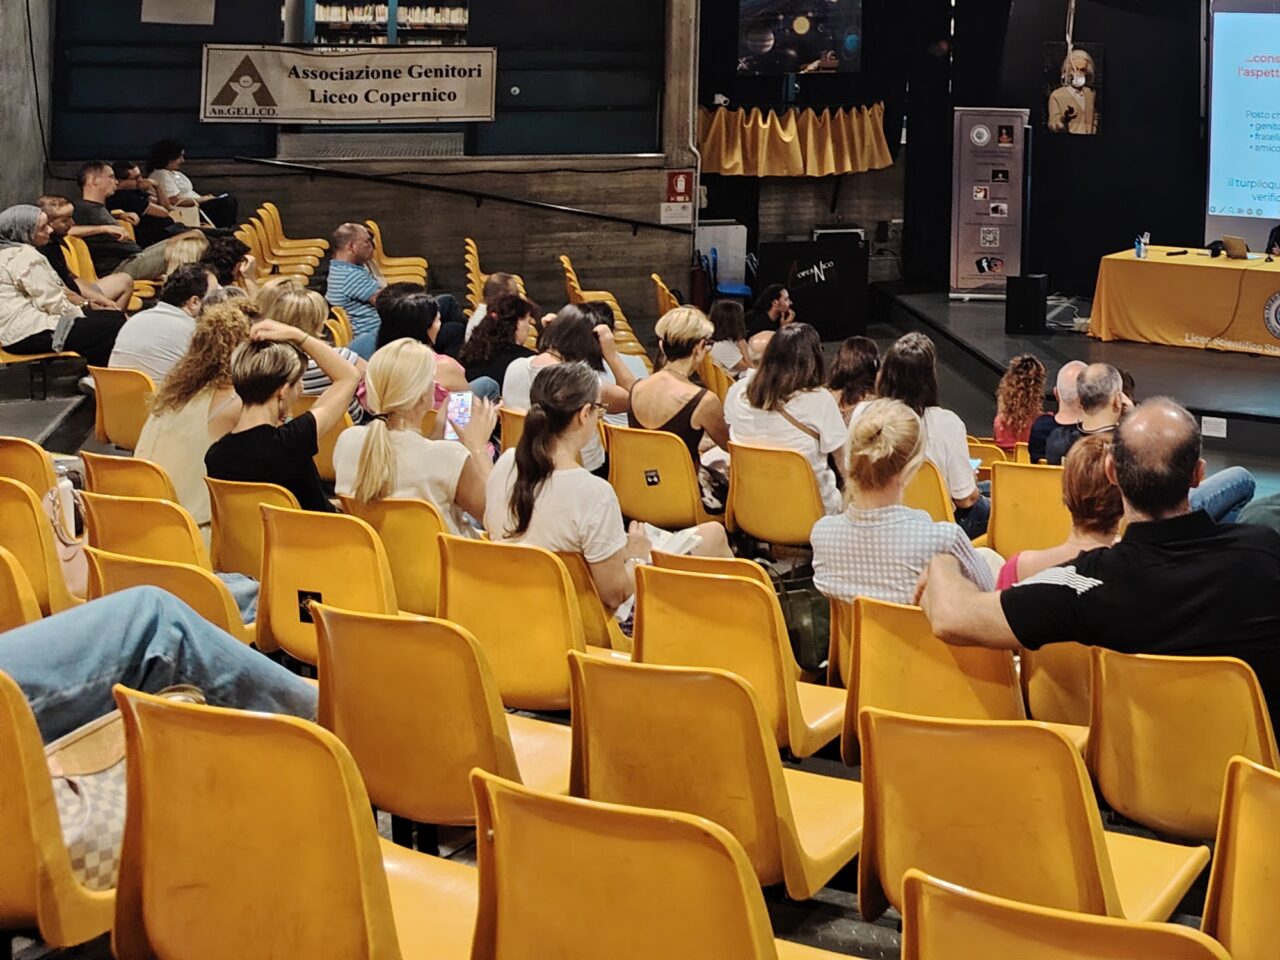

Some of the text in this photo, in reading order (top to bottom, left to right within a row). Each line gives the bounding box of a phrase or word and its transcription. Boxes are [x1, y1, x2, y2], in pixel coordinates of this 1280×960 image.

[287, 64, 482, 81] Associazione Genitori
[309, 88, 457, 106] Liceo Copernico
[1246, 110, 1270, 119] Posto
